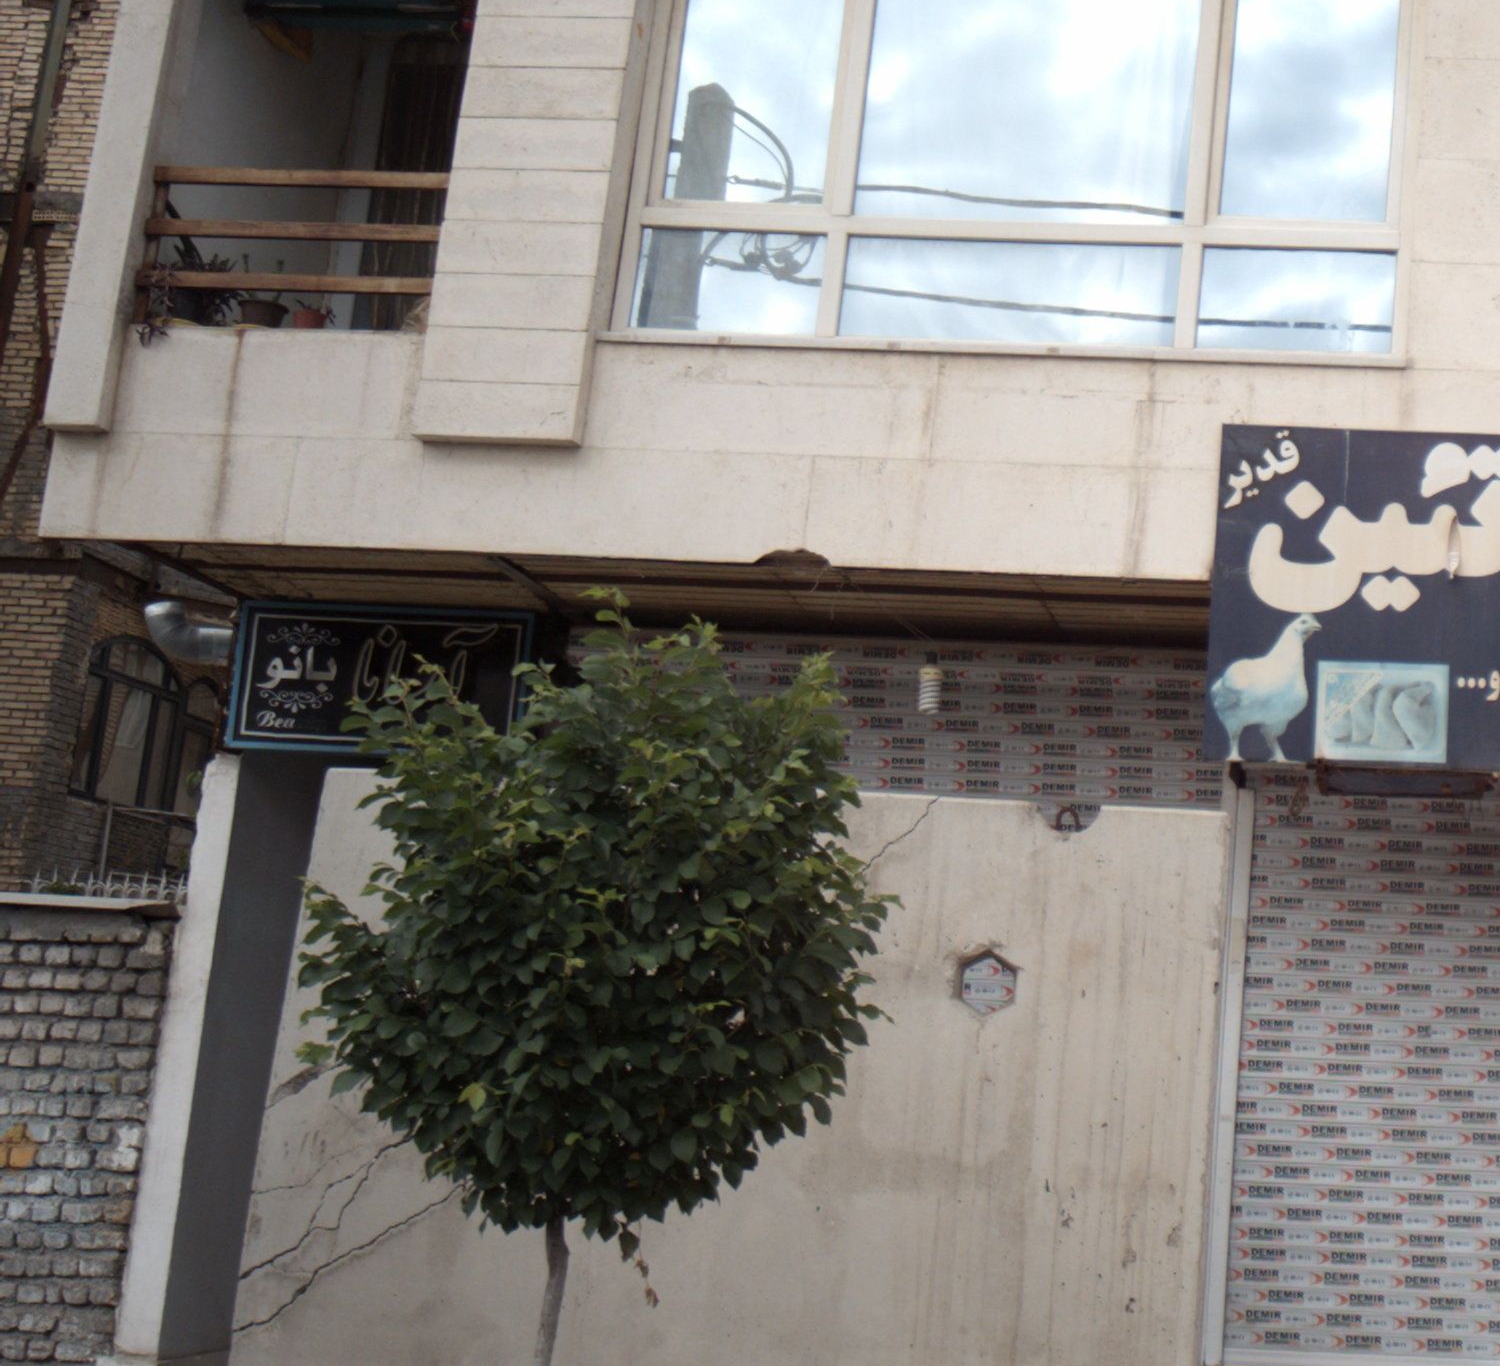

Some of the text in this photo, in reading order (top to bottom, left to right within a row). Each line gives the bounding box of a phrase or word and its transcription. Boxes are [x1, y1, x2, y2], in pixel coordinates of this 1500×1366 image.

[1223, 429, 1300, 509] قدیر
[255, 644, 338, 694] بانو
[851, 695, 887, 705] DEMIR
[1002, 701, 1038, 711] DEMIR
[1078, 704, 1114, 714] DEMIR
[1155, 707, 1191, 717] DEMIR
[869, 716, 905, 726] DEMIR
[944, 719, 980, 729] DEMIR
[1020, 722, 1056, 732] DEMIR
[1096, 725, 1132, 735] DEMIR
[889, 776, 925, 786] DEMIR
[965, 779, 1001, 789] DEMIR
[1041, 782, 1077, 792] DEMIR
[1118, 785, 1154, 795] DEMIR
[1309, 836, 1345, 846] DEMIR
[1301, 856, 1337, 866] DEMIR
[1380, 859, 1416, 869] DEMIR
[1311, 877, 1347, 887] DEMIR
[1269, 896, 1305, 906] DEMIR
[1347, 899, 1383, 909] DEMIR
[1252, 915, 1288, 925] DEMIR
[1409, 922, 1445, 932] DEMIR
[1311, 938, 1347, 948] DEMIR
[1389, 942, 1425, 952] DEMIR
[1295, 958, 1331, 968] DEMIR
[1373, 961, 1409, 971] DEMIR
[1317, 979, 1353, 989] DEMIR
[1286, 999, 1322, 1009] DEMIR
[1365, 1002, 1401, 1012] DEMIR
[1259, 1018, 1295, 1028] DEMIR
[1338, 1022, 1374, 1032] DEMIR
[1256, 1038, 1292, 1048] DEMIR
[1335, 1042, 1371, 1052] DEMIR
[1414, 1045, 1450, 1055] DEMIR
[1248, 1059, 1284, 1069] DEMIR
[1407, 1066, 1443, 1076] DEMIR
[1279, 1082, 1315, 1092] DEMIR
[1358, 1085, 1394, 1095] DEMIR
[1302, 1104, 1338, 1114] DEMIR
[1382, 1107, 1418, 1117] DEMIR
[1311, 1125, 1347, 1135] DEMIR
[1392, 1128, 1428, 1138] DEMIR
[1257, 1144, 1293, 1154] DEMIR
[1336, 1147, 1372, 1157] DEMIR
[1416, 1151, 1452, 1161] DEMIR
[1274, 1165, 1310, 1175] DEMIR
[1355, 1169, 1391, 1179] DEMIR
[1436, 1173, 1472, 1183] DEMIR
[1248, 1185, 1284, 1195] DEMIR
[1328, 1189, 1364, 1199] DEMIR
[1408, 1192, 1444, 1202] DEMIR
[1287, 1208, 1323, 1218] DEMIR
[1367, 1211, 1403, 1221] DEMIR
[1447, 1214, 1483, 1224] DEMIR
[1249, 1227, 1285, 1237] DEMIR
[1329, 1230, 1365, 1240] DEMIR
[1409, 1234, 1445, 1244] DEMIR
[1251, 1247, 1287, 1257] DEMIR
[1331, 1251, 1367, 1261] DEMIR
[1244, 1268, 1280, 1278] DEMIR
[1324, 1272, 1360, 1282] DEMIR
[1405, 1275, 1441, 1285] DEMIR
[1268, 1289, 1304, 1299] DEMIR
[1349, 1293, 1385, 1303] DEMIR
[1430, 1297, 1466, 1307] DEMIR
[1326, 1313, 1362, 1323] DEMIR
[1407, 1317, 1443, 1327] DEMIR
[1265, 1331, 1301, 1341] DEMIR
[1427, 1338, 1463, 1348] DEMIR
